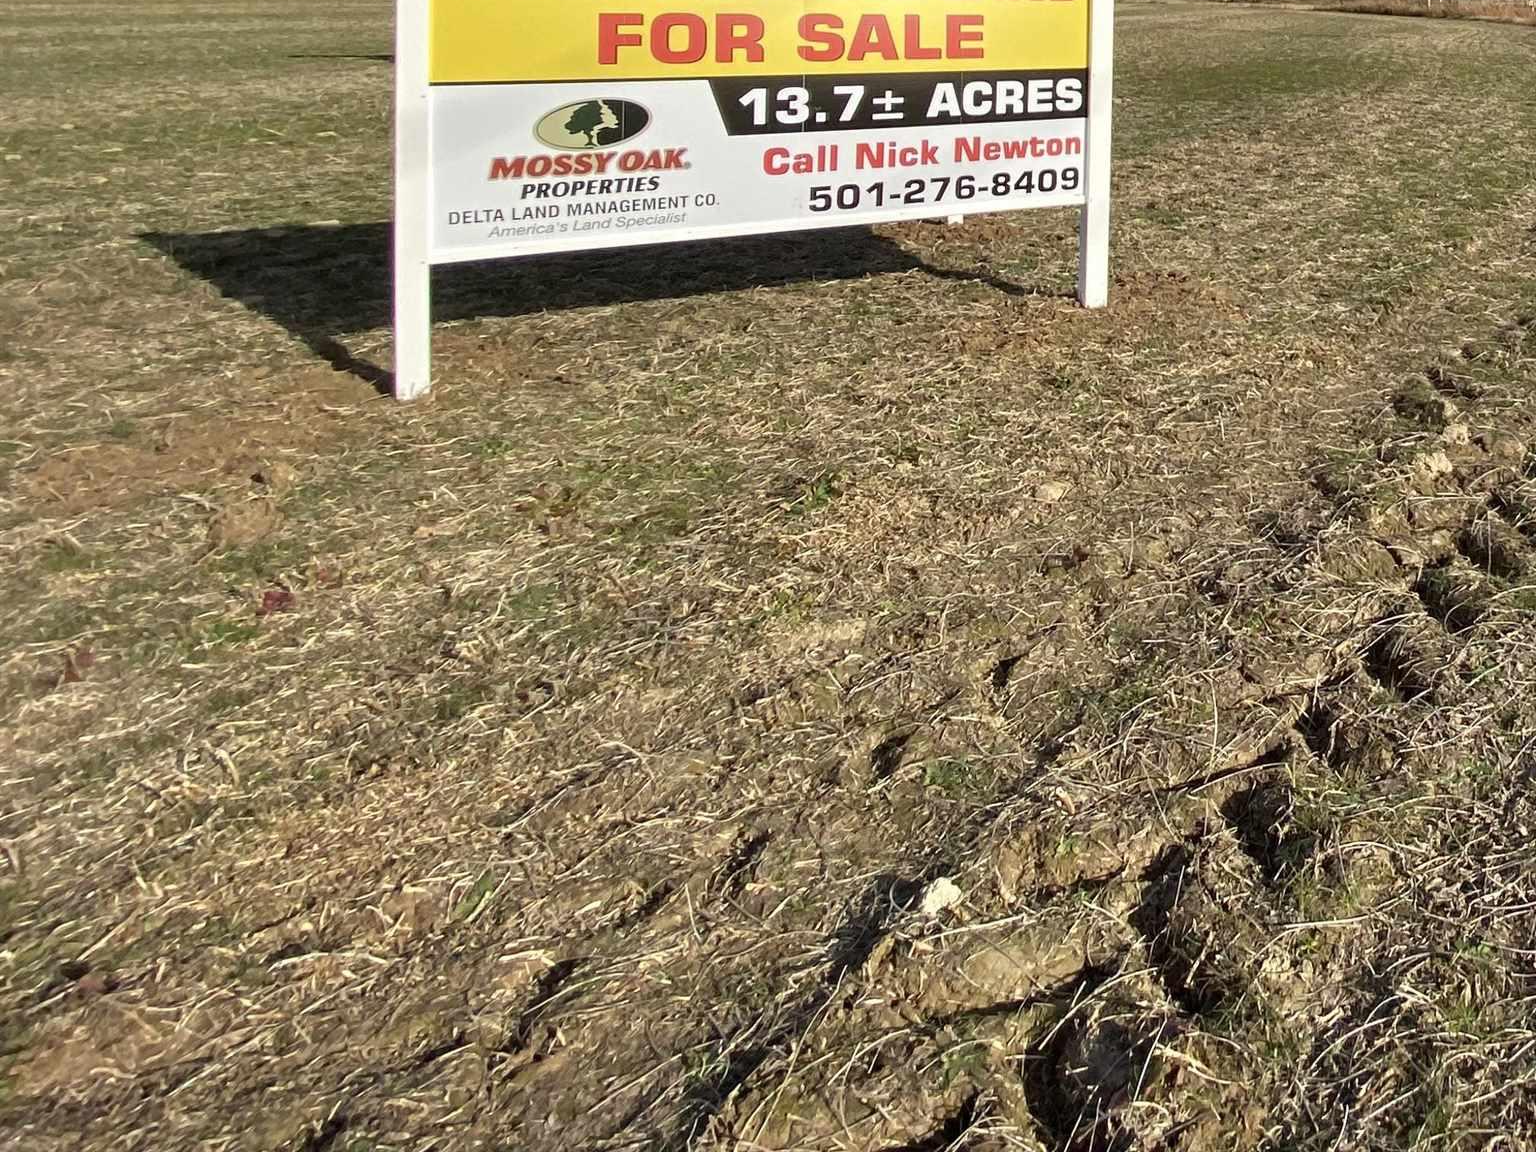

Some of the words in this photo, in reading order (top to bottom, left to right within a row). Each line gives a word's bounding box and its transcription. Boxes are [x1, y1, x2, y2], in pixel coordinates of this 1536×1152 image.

[598, 12, 765, 65] FOR
[797, 13, 985, 62] SALE
[739, 85, 905, 126] 13.7±
[926, 78, 1083, 118] ACRES
[489, 153, 617, 180] MOSSY
[763, 145, 838, 176] Call
[856, 139, 939, 170] Nick
[954, 136, 1081, 163] Newton
[520, 176, 660, 199] PROPERTIES
[809, 167, 1080, 212] 501-276-8409
[449, 209, 504, 225] DELTA
[512, 204, 560, 221] LAND
[567, 195, 689, 217] MANAGEMENT
[694, 193, 720, 208] CO.
[488, 221, 567, 239] America's
[572, 217, 610, 232] Land
[616, 212, 687, 228] Specialist
